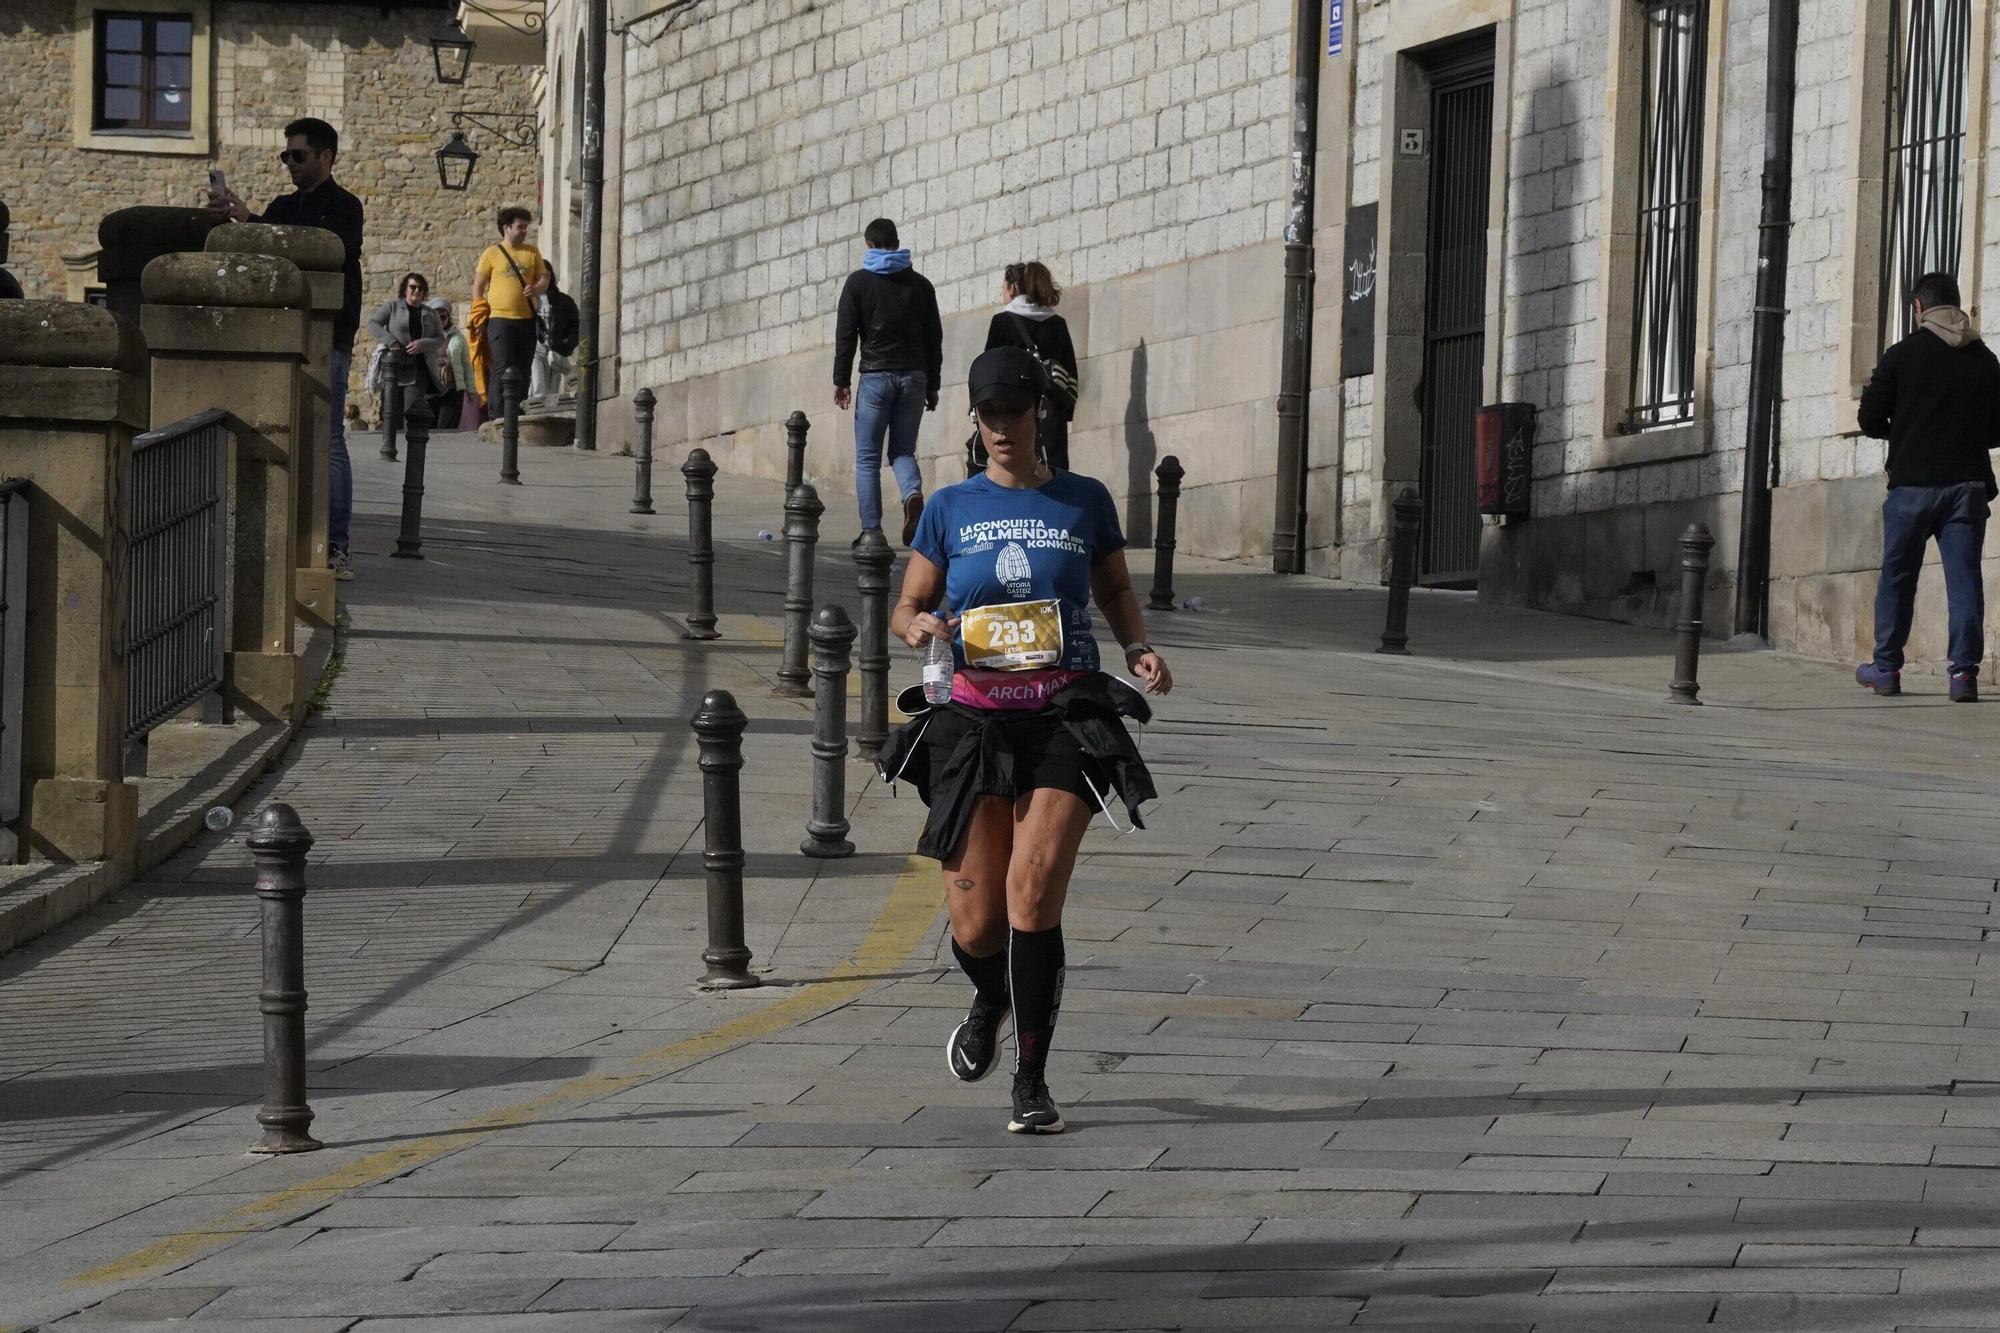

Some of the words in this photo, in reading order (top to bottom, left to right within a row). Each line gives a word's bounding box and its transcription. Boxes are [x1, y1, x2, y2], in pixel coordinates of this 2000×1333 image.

[960, 525, 973, 537] LA
[973, 519, 1045, 532] CONQUISTA
[961, 534, 970, 543] DE
[970, 532, 977, 540] LA
[976, 527, 1070, 544] ALMENDRA
[1027, 539, 1085, 554] KONKISTA
[1040, 606, 1053, 614] 10K
[987, 619, 1036, 647] 233
[1038, 674, 1069, 698] MAX
